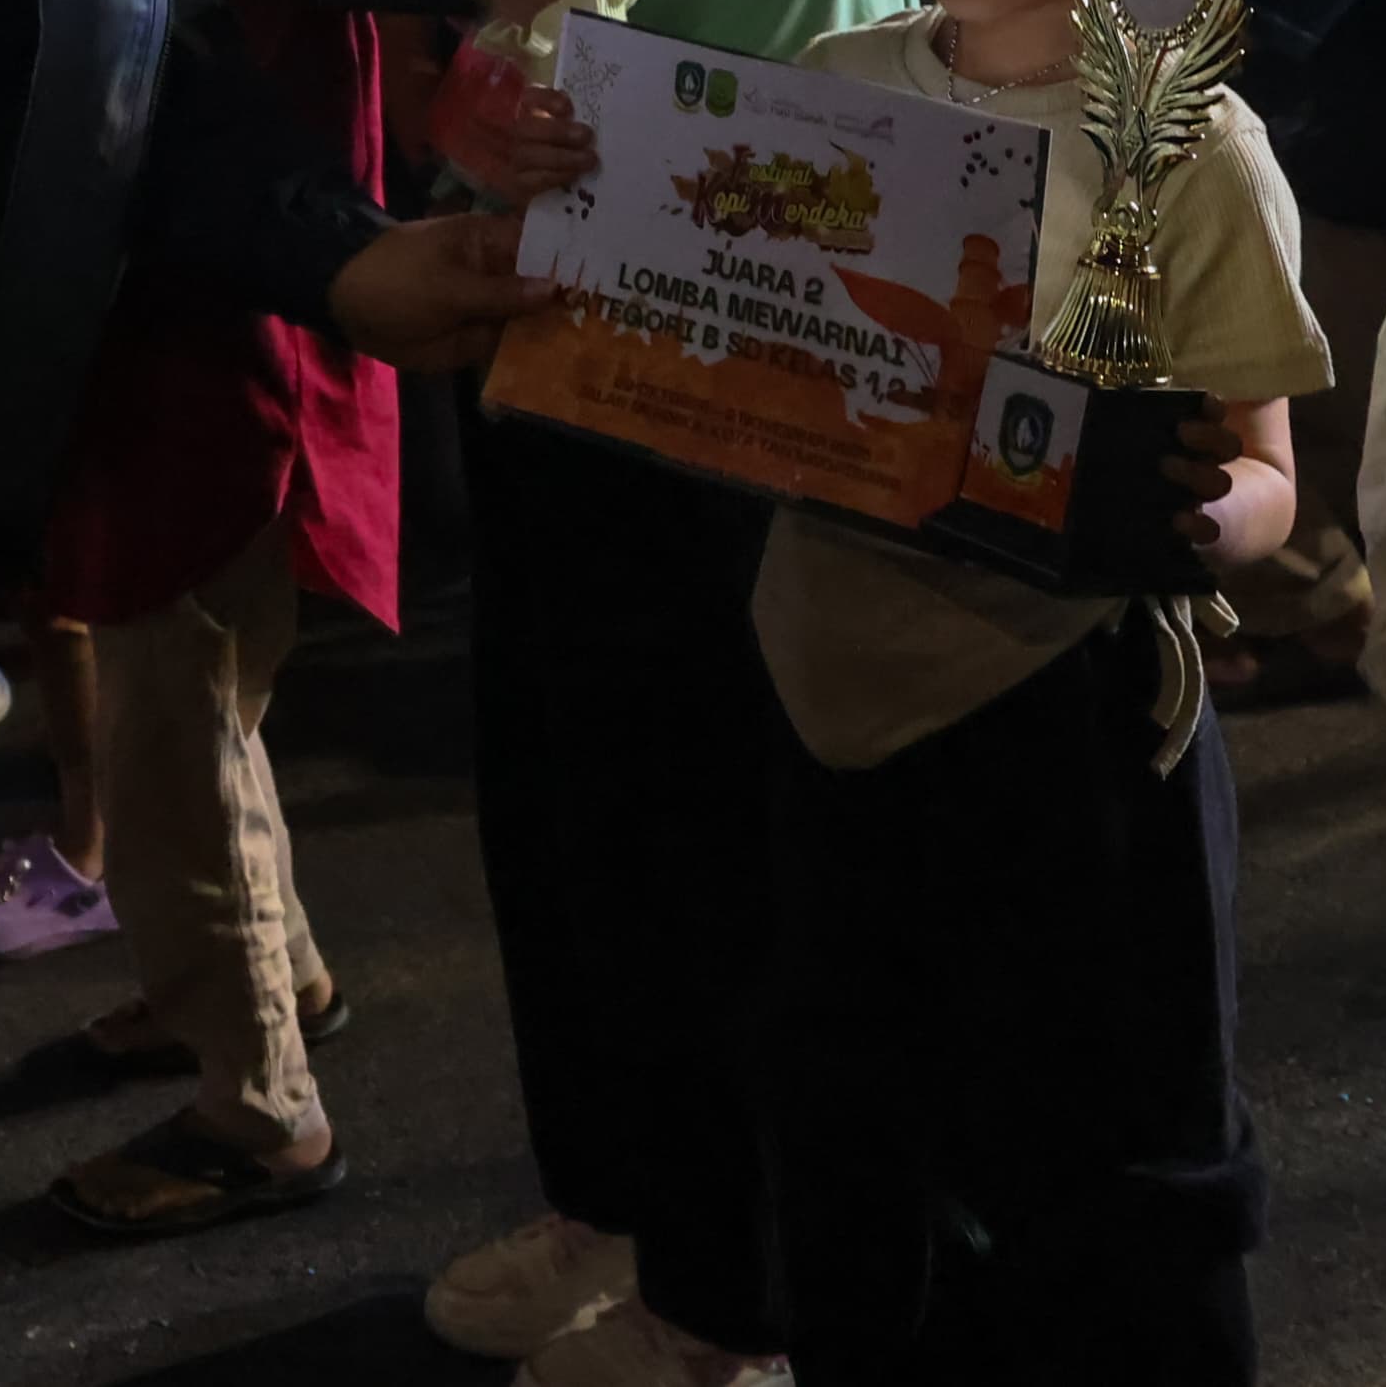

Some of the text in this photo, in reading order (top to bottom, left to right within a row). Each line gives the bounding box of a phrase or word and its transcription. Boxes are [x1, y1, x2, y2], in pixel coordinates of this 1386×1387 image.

[702, 249, 824, 306] JUARA 2
[618, 262, 905, 368] LOMBA MEWARNAI
[702, 324, 719, 350] B
[769, 341, 858, 390] KELAS
